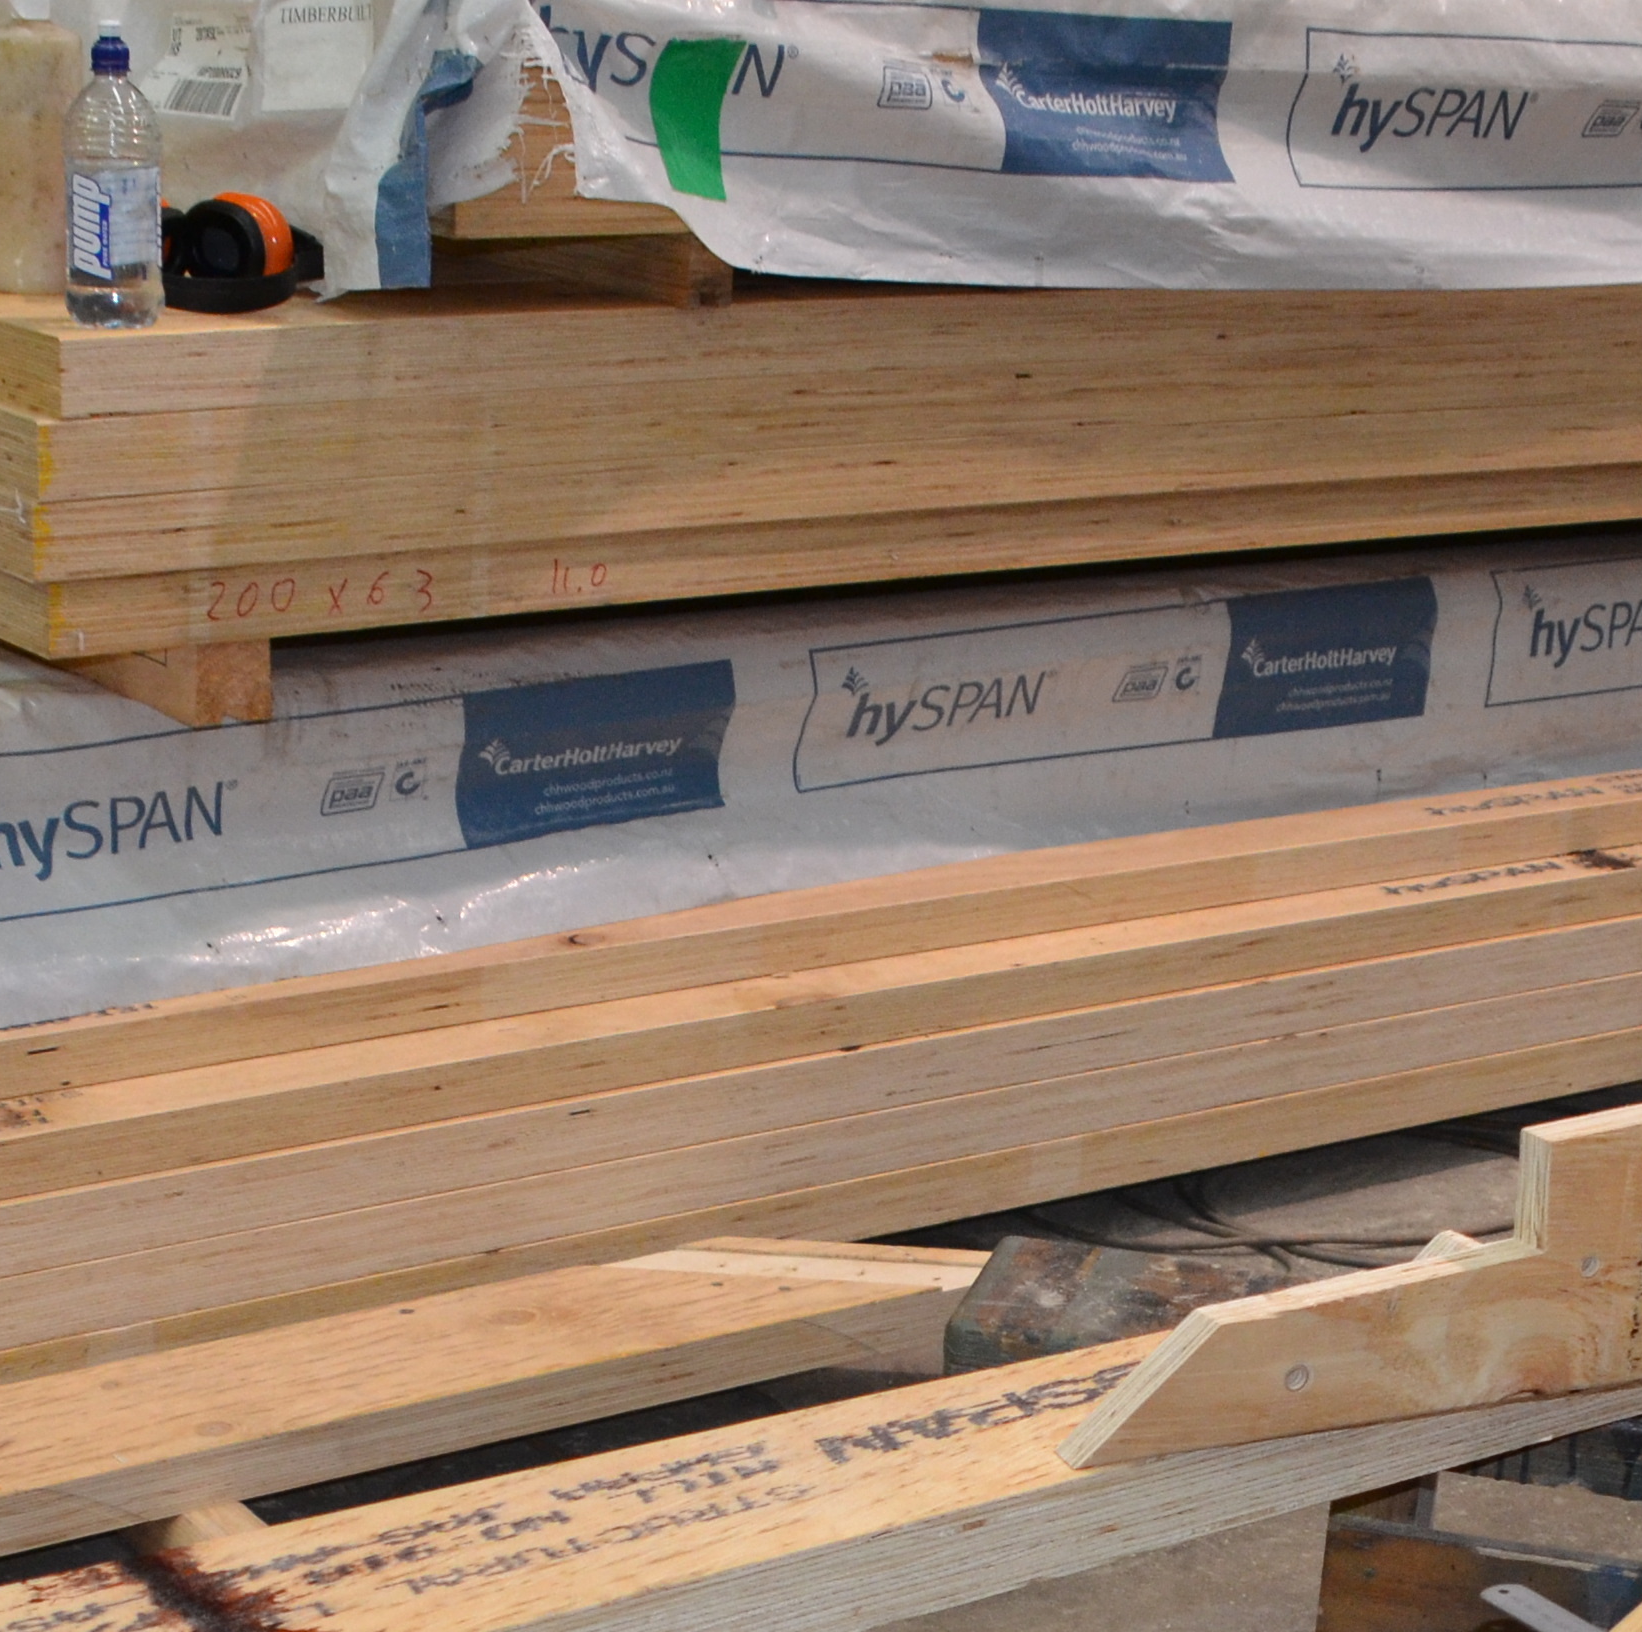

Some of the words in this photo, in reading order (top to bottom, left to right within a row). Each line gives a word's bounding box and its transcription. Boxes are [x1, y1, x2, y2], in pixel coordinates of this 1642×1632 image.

[1016, 86, 1176, 122] CarterHoltHarvey
[1331, 84, 1531, 152] hySPAN
[206, 578, 296, 621] 200
[1253, 646, 1397, 677] CarterHoltHarvey
[846, 670, 1046, 746] hySPAN
[495, 737, 683, 775] CarterHoltHarvey
